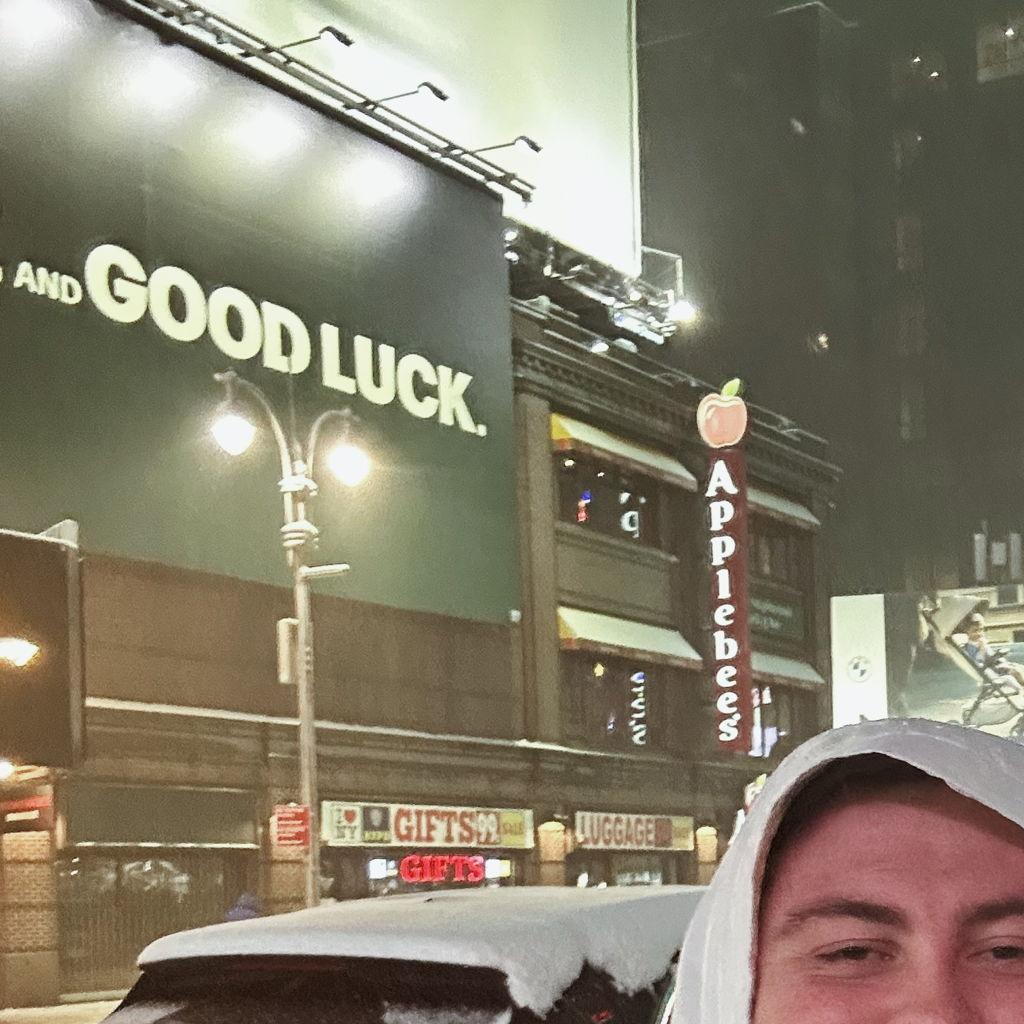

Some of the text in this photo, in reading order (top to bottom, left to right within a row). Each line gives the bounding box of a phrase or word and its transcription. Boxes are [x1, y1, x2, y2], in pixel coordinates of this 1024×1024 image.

[13, 244, 488, 437] AND GOOD LUCK.
[394, 807, 476, 845] GIFTS
[580, 815, 655, 847] LUGGAGE
[400, 854, 485, 883] GIFTS
